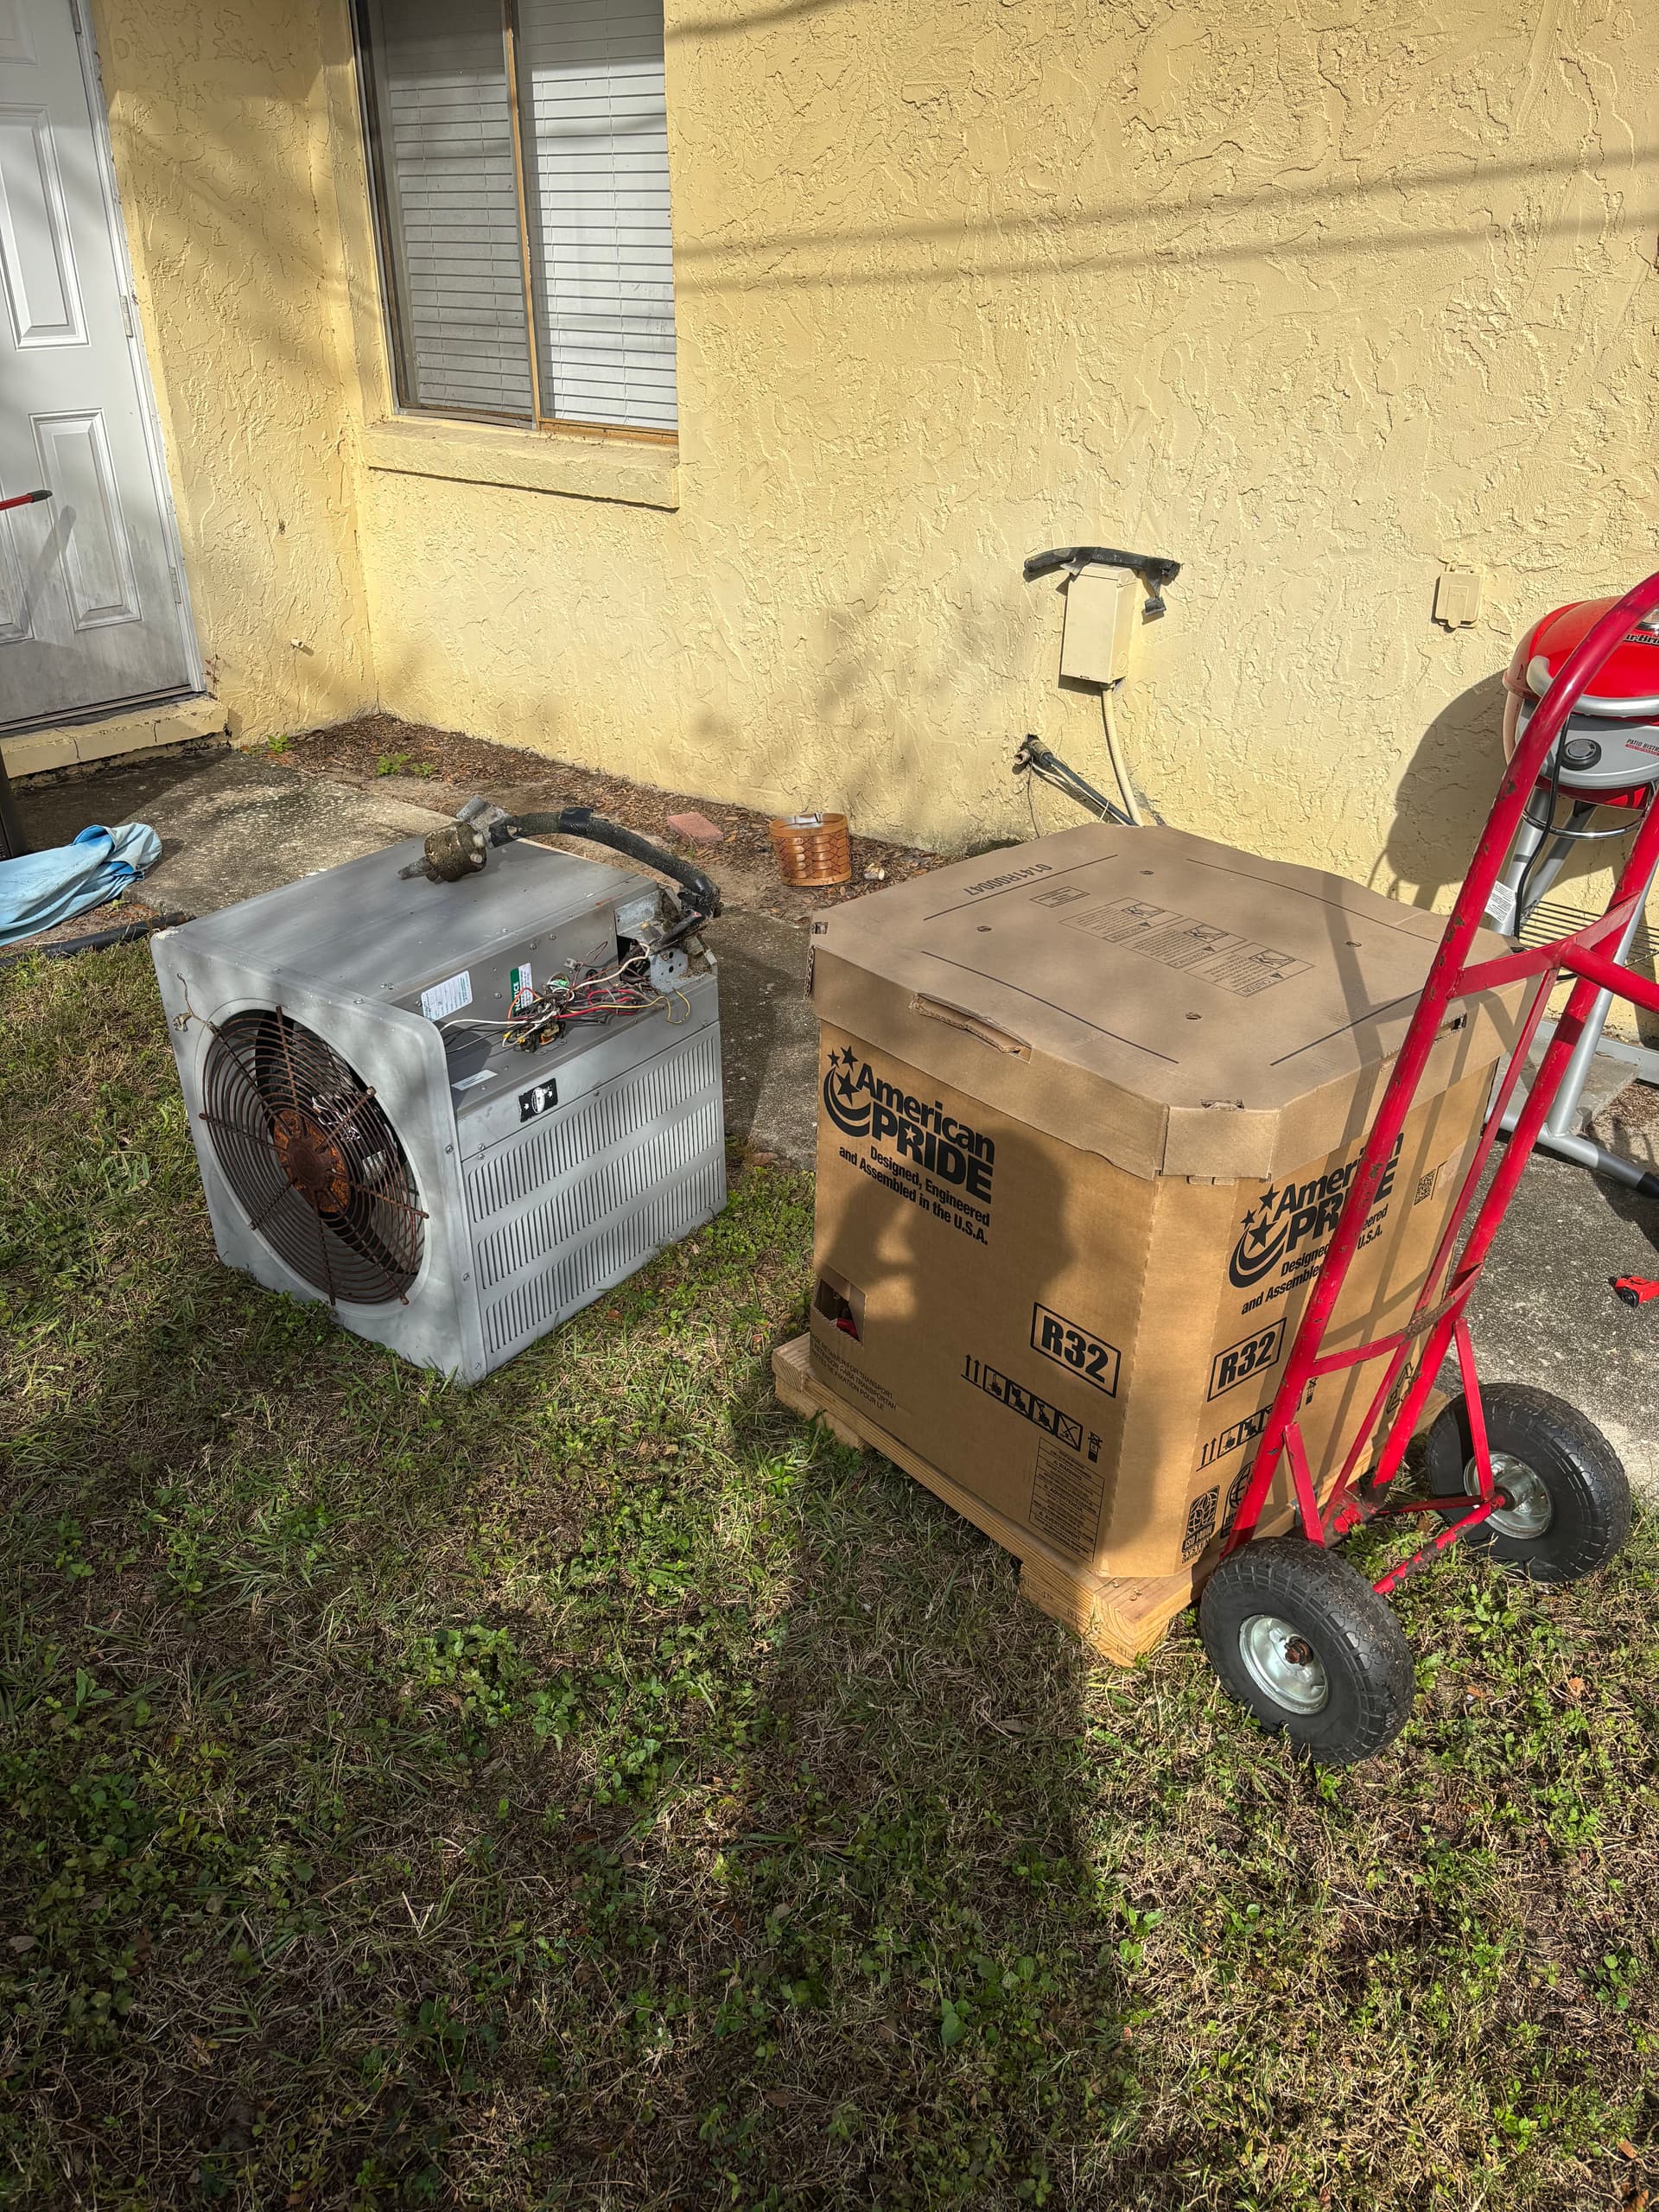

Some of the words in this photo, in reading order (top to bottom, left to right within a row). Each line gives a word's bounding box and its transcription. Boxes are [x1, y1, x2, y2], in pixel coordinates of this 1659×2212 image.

[963, 863, 1052, 896] 0141R00047
[856, 1063, 995, 1164] American
[871, 1101, 992, 1205] PRIDE
[839, 1146, 858, 1166] and
[859, 1160, 916, 1203] Assembled
[918, 1193, 930, 1211] in
[932, 1202, 951, 1224] the
[954, 1216, 989, 1246] U.S.A.
[870, 1146, 923, 1188] Designed,
[925, 1178, 990, 1228] Engineered
[1241, 1294, 1263, 1315] and
[1357, 1224, 1383, 1250] U.S.A.
[1041, 1315, 1109, 1384] R32
[1217, 1331, 1275, 1390] R32
